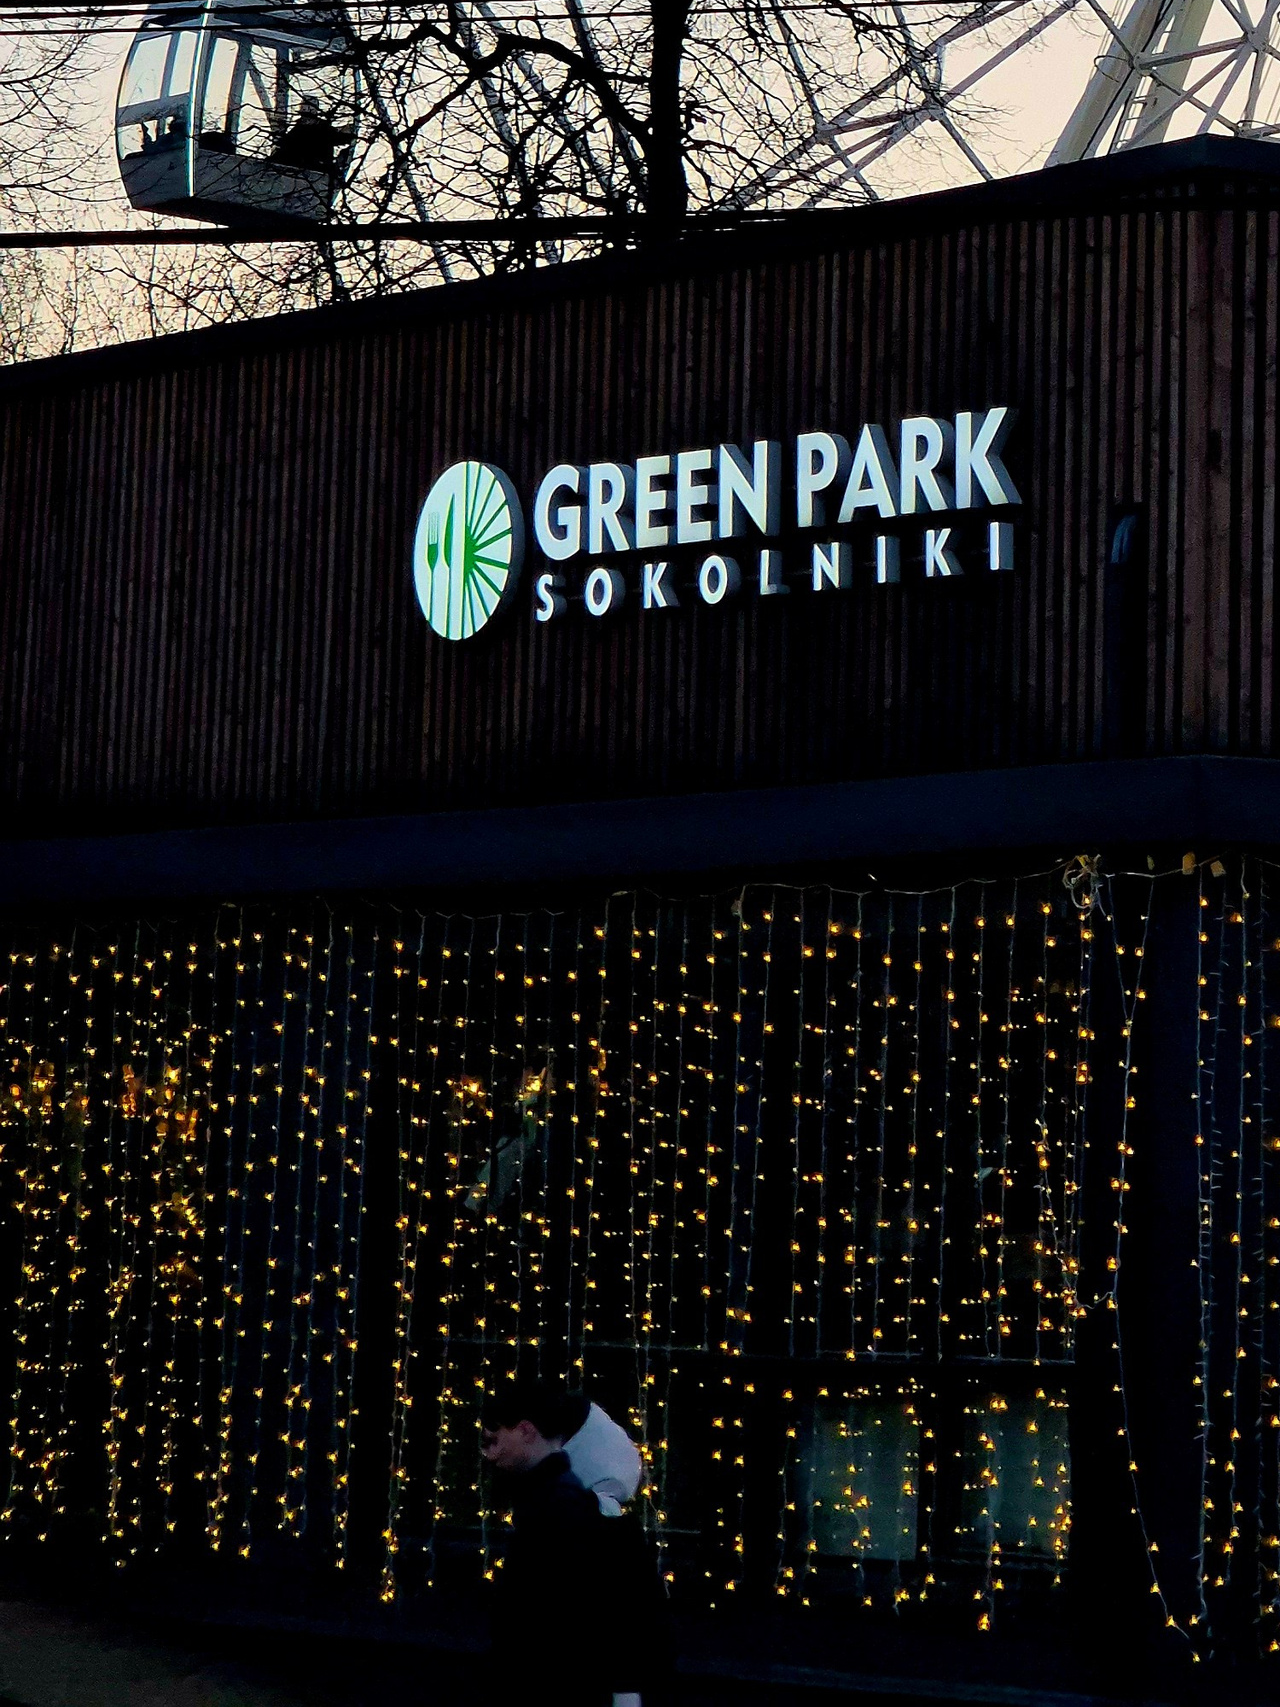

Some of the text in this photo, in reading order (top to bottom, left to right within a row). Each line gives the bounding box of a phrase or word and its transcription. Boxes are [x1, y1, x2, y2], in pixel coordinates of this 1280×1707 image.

[534, 406, 1021, 562] GREEN PARK
[535, 522, 1015, 623] SOKOLNIKI
